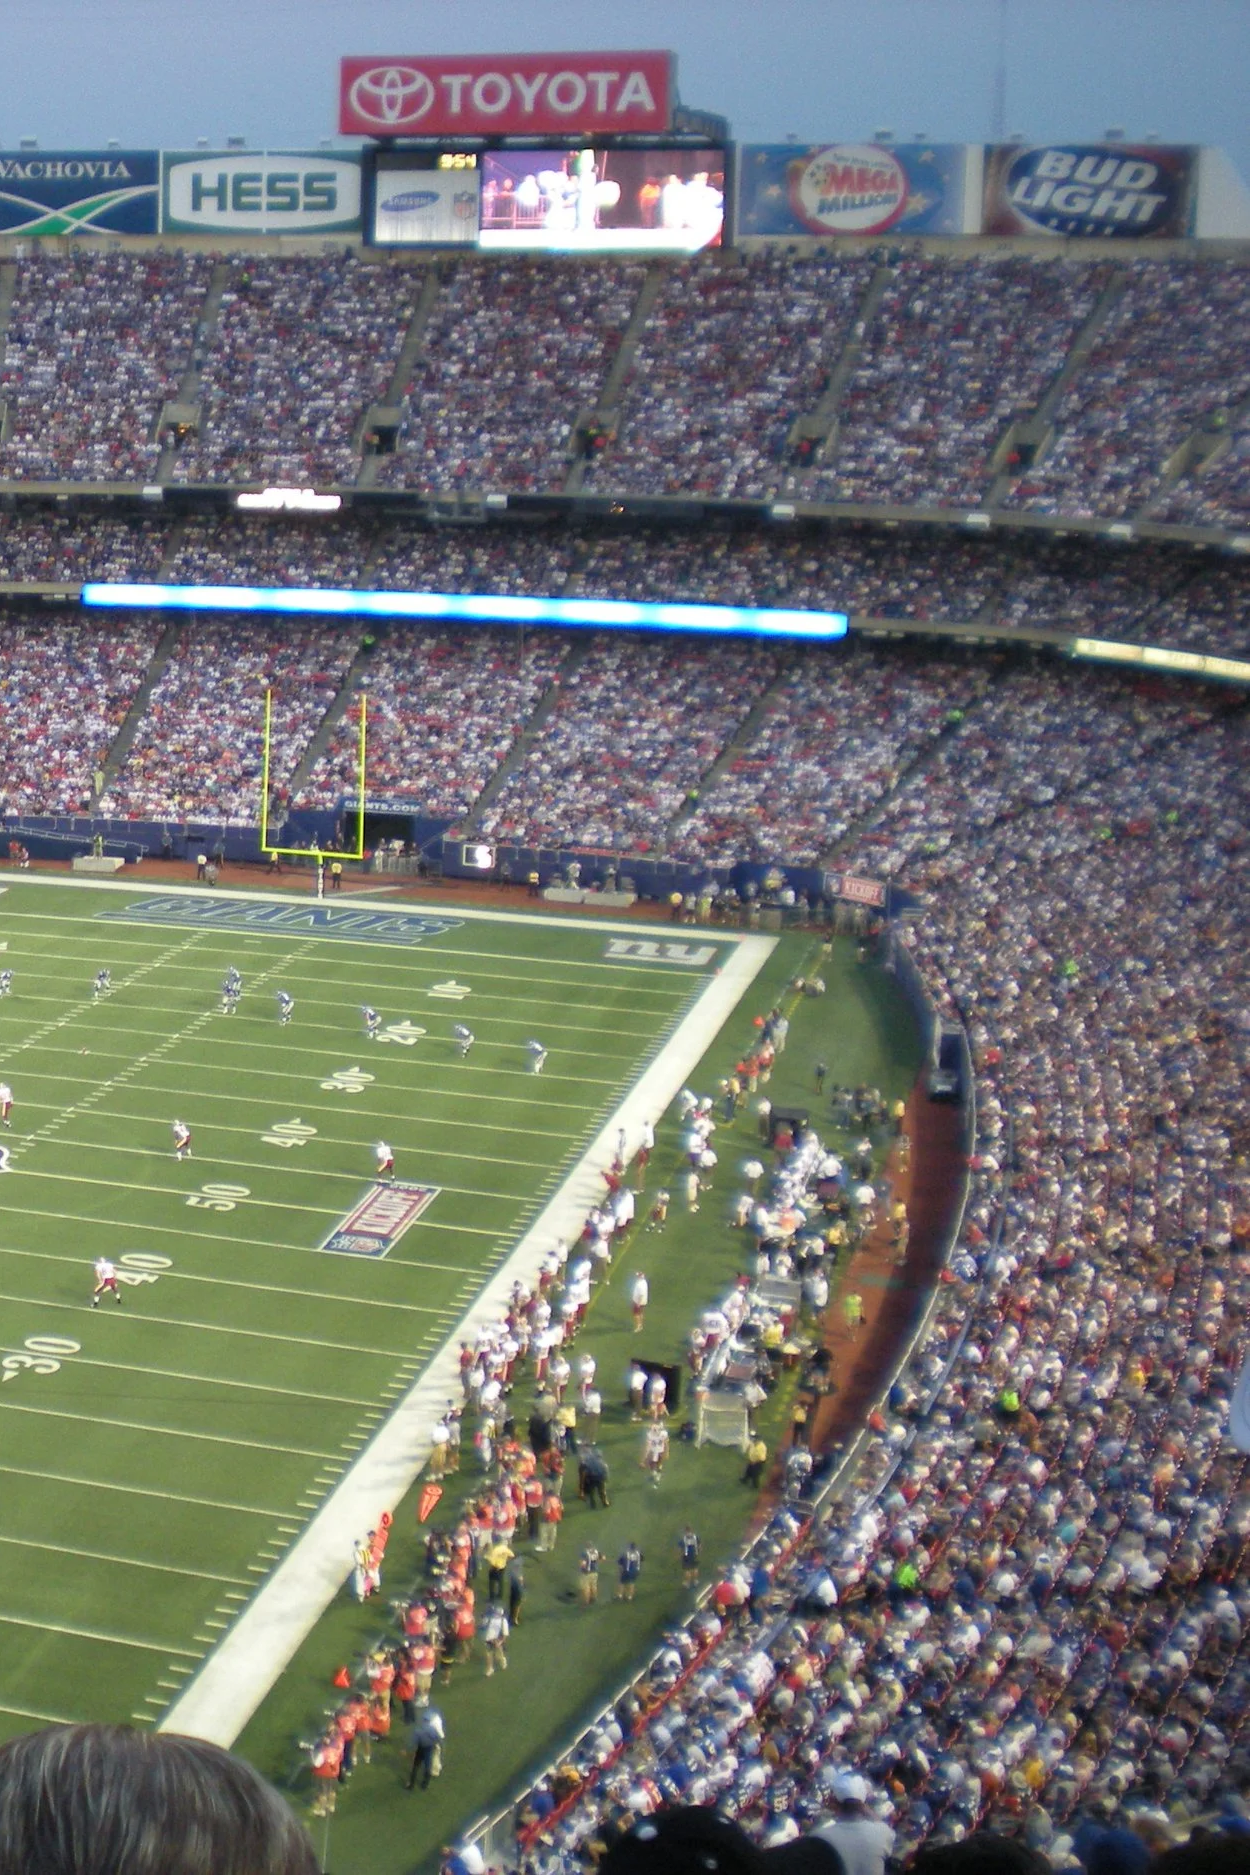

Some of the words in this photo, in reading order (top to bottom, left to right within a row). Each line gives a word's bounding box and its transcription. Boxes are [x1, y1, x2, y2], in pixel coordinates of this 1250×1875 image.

[440, 71, 656, 114] TOYOTA
[819, 162, 898, 196] MEGA
[1036, 150, 1158, 190] BUD
[191, 172, 338, 212] HESS
[1012, 176, 1167, 222] LIGHT
[125, 897, 465, 935] GIANTS
[427, 983, 472, 1000] 10
[376, 1024, 427, 1046] 20
[320, 1071, 375, 1094] 30
[260, 1122, 318, 1148] 40
[186, 1184, 251, 1212] 50
[115, 1253, 173, 1286] 40
[2, 1336, 81, 1375] 30
